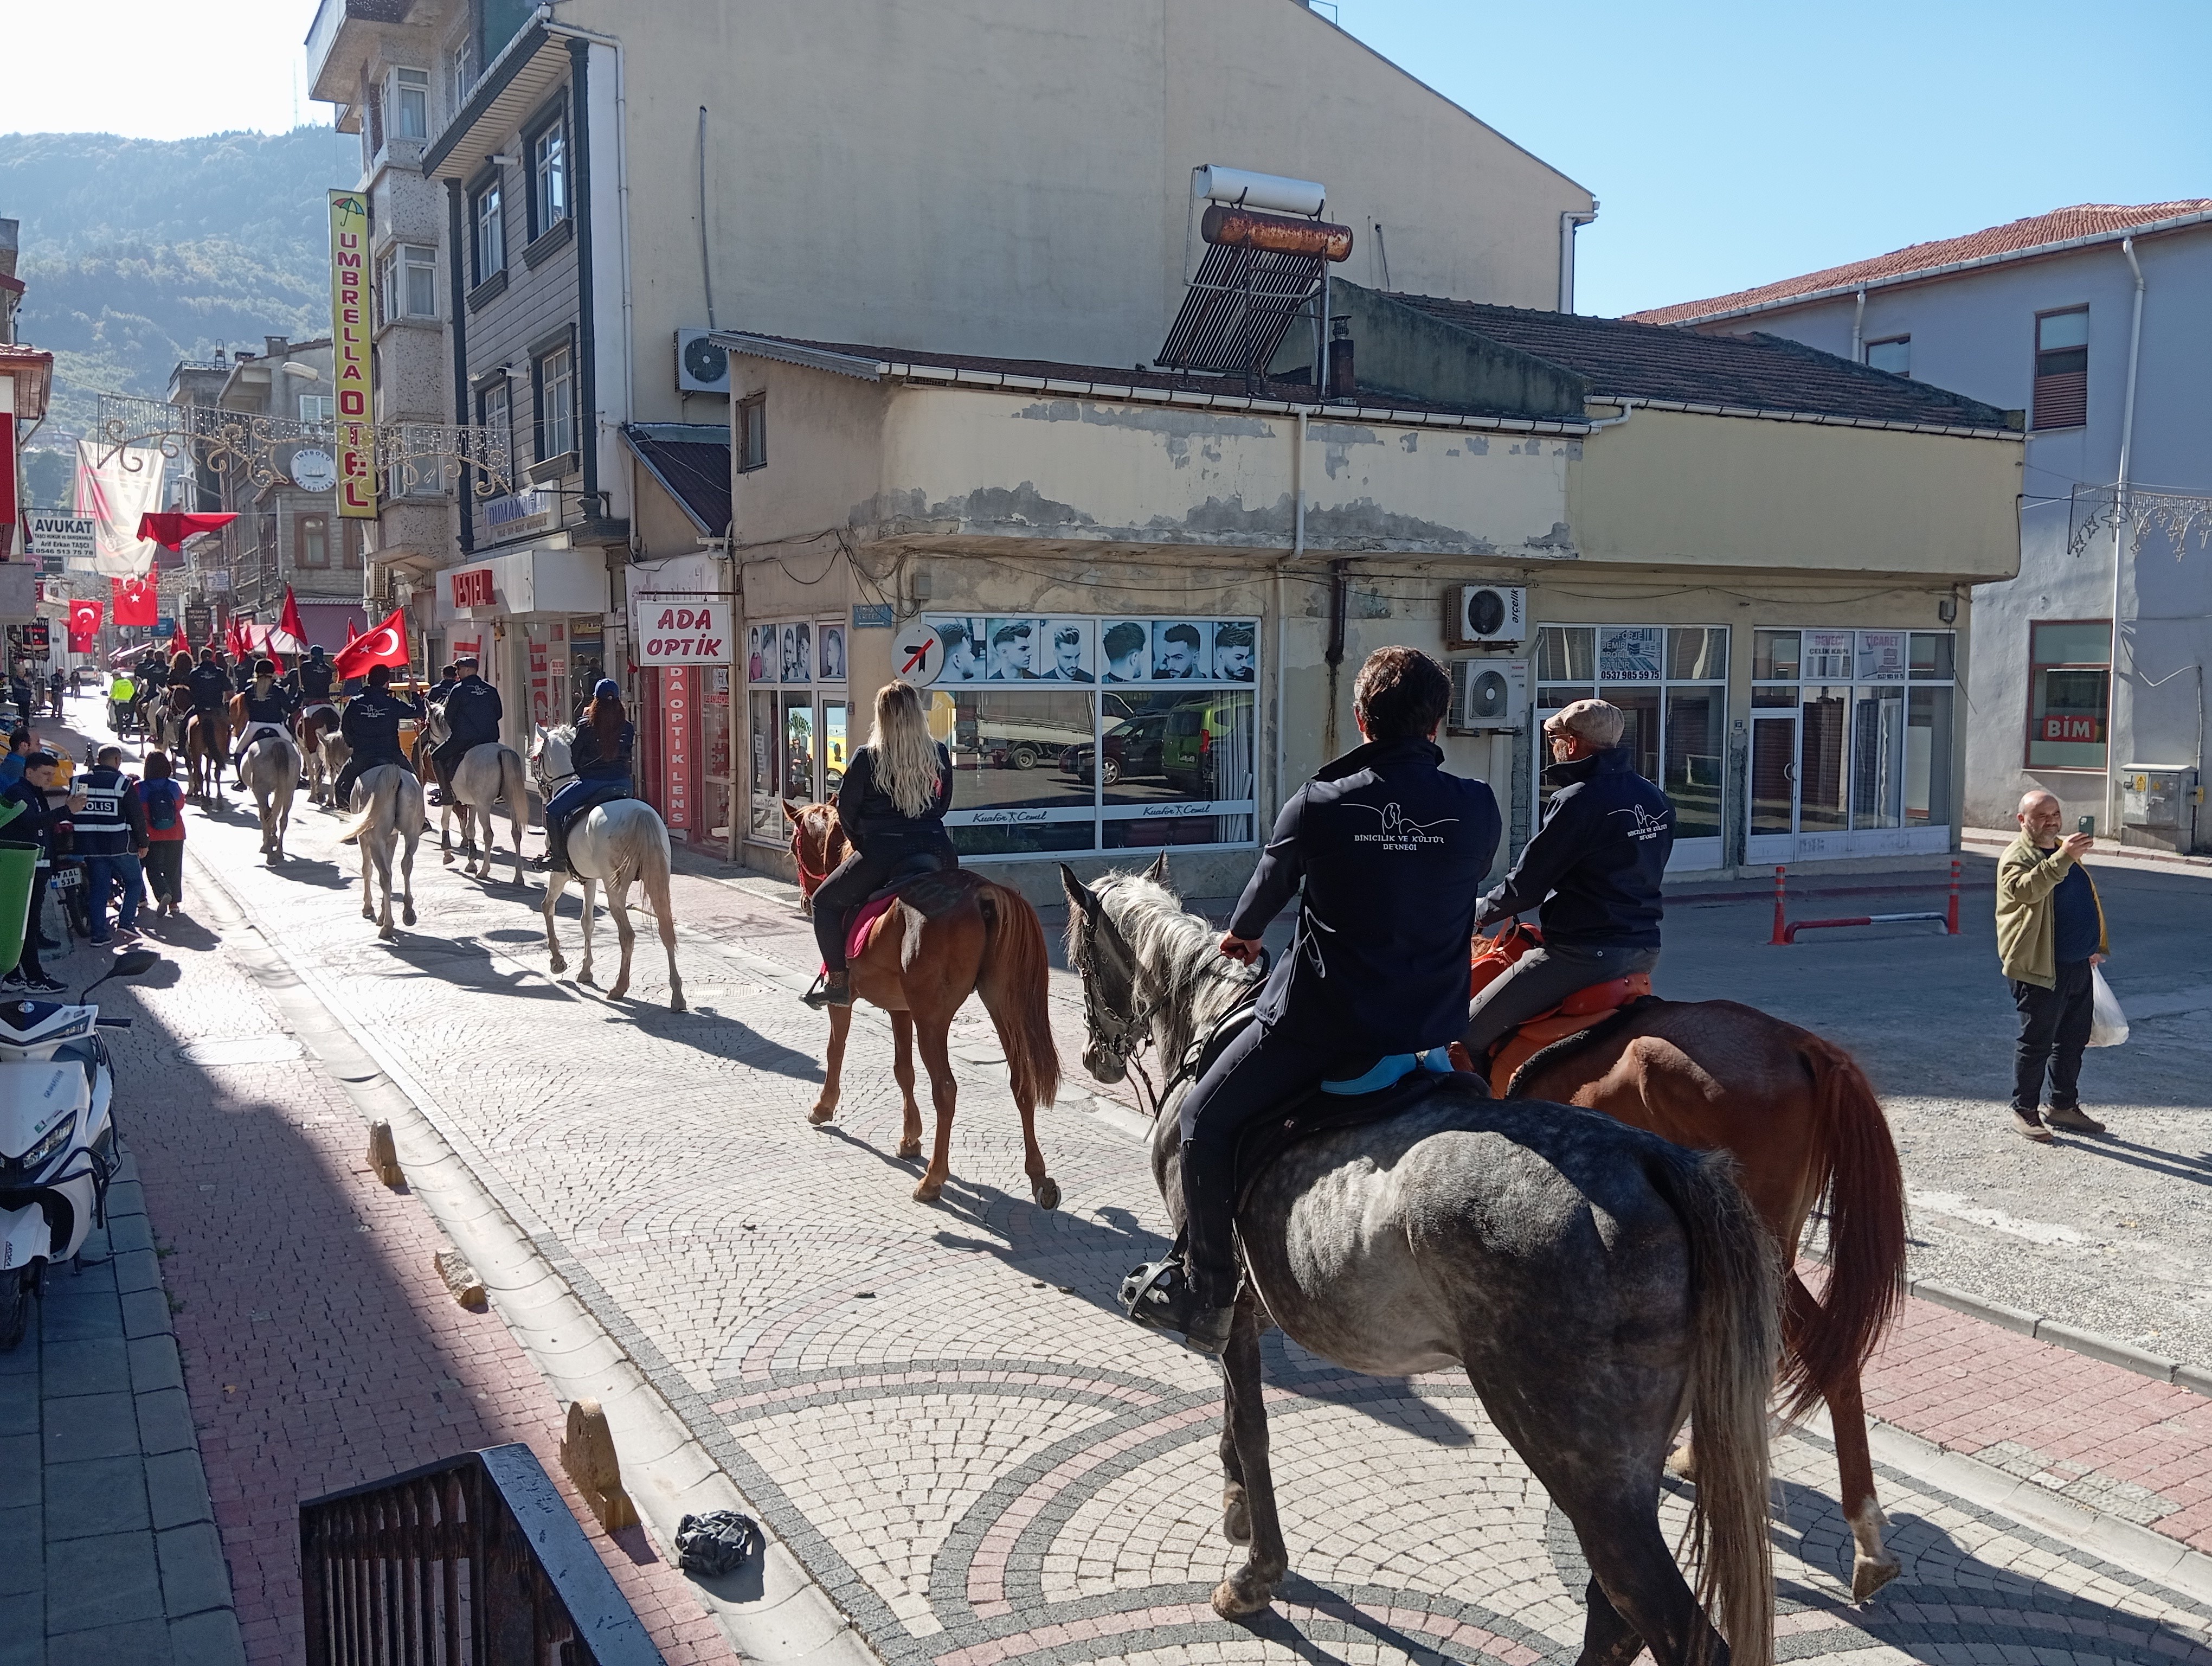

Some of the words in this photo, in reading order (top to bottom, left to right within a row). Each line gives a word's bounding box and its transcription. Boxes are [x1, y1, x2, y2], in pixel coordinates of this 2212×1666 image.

[337, 232, 362, 381] UMBRELLA
[339, 389, 369, 508] OTEL
[295, 450, 331, 462] İNEBOLU
[295, 477, 335, 491] BELEDİYESİ
[35, 519, 93, 534] AVUKAT
[451, 570, 486, 608] VESTEL
[1510, 588, 1520, 624] arçelik
[658, 609, 711, 630] ADA
[647, 633, 722, 657] OPTİK
[1601, 640, 1626, 649] DEMİR
[1815, 634, 1844, 646] DEVECİ
[1865, 634, 1899, 646] TİCARET
[1601, 650, 1630, 658] PROFİL
[1601, 671, 1621, 679] 0537
[1622, 671, 1637, 679] 985
[1639, 671, 1649, 679] 59
[1650, 671, 1659, 679] 75
[670, 699, 684, 764] OPTİK
[2048, 716, 2089, 738] BİM
[671, 772, 684, 823] LENS
[85, 802, 112, 811] OLİS
[1143, 806, 1175, 816] Kuaför
[973, 812, 1007, 823] Kuaför
[1017, 811, 1047, 821] Cemil
[63, 869, 79, 878] AAL
